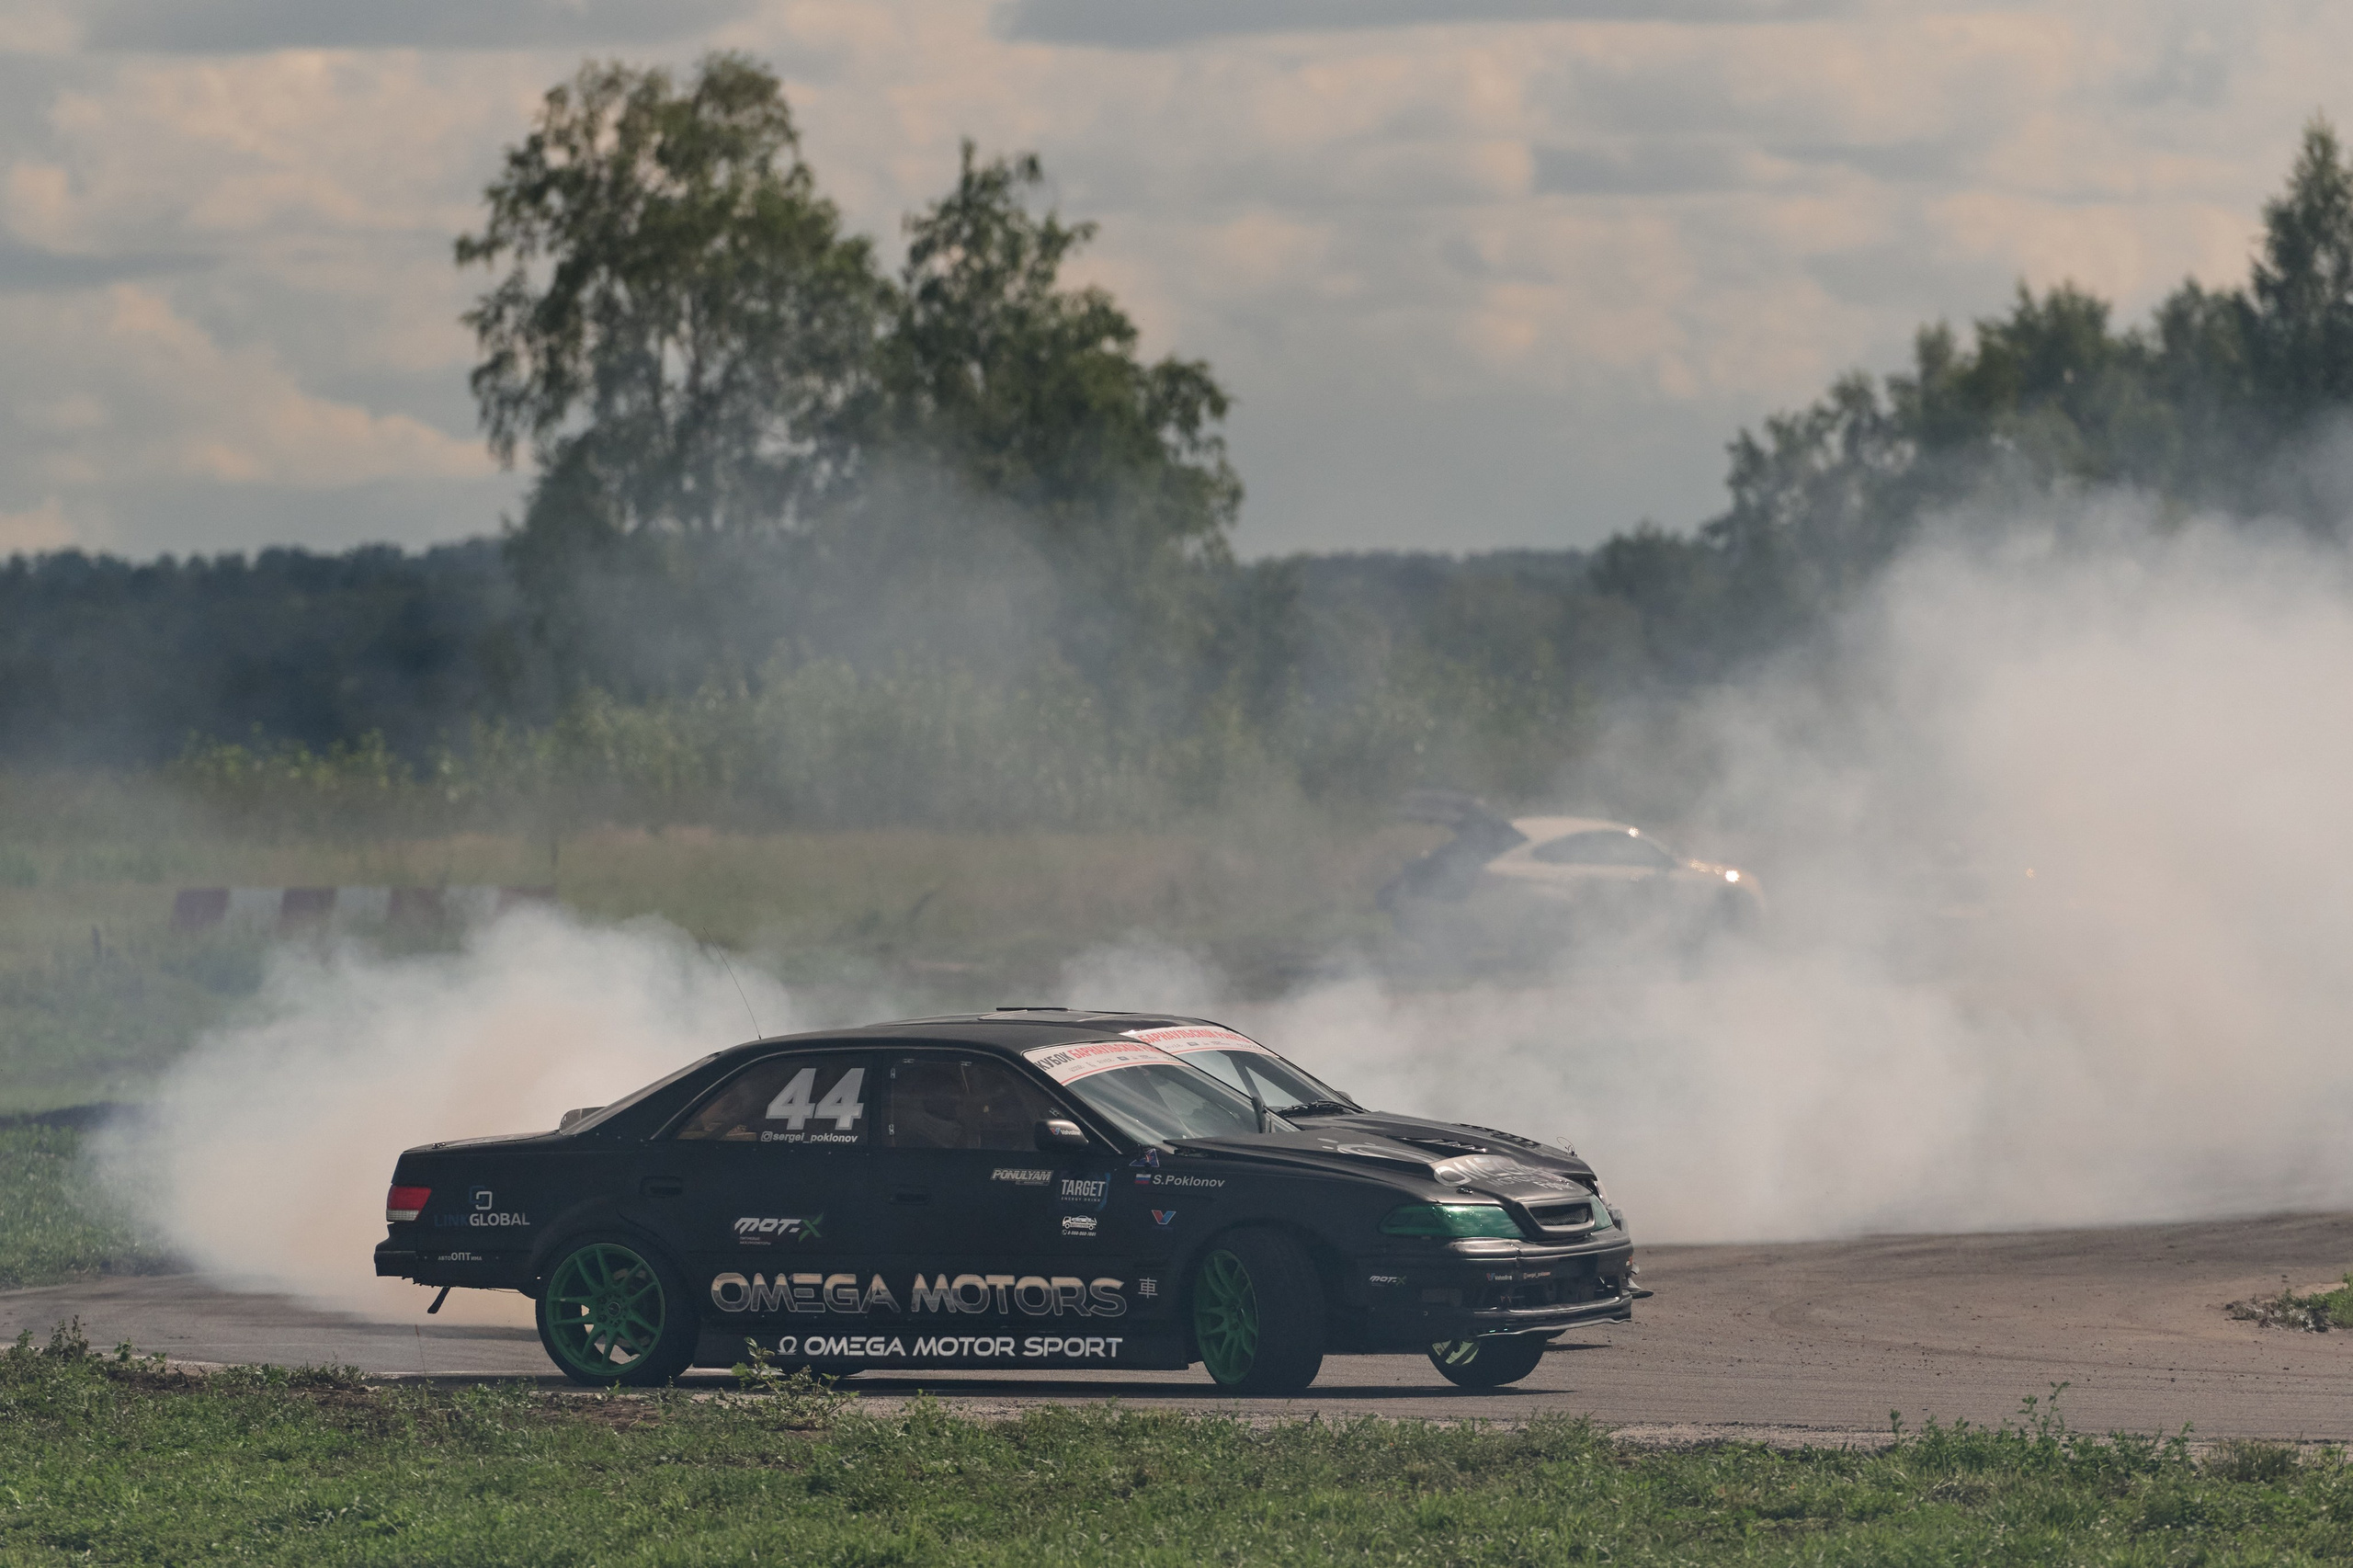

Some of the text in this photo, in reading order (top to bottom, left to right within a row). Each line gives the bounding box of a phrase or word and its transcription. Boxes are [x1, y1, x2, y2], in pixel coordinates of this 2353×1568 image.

[1034, 1051, 1075, 1072] КУБОК
[765, 1068, 865, 1130] 44
[1061, 1179, 1106, 1197] TARGET
[1153, 1175, 1225, 1187] S.Poklonov
[710, 1272, 1128, 1317] OMEGA MOTORS
[803, 1335, 906, 1357] OMEGA
[913, 1336, 1017, 1358] MOTOR
[1021, 1336, 1123, 1358] SPORT
